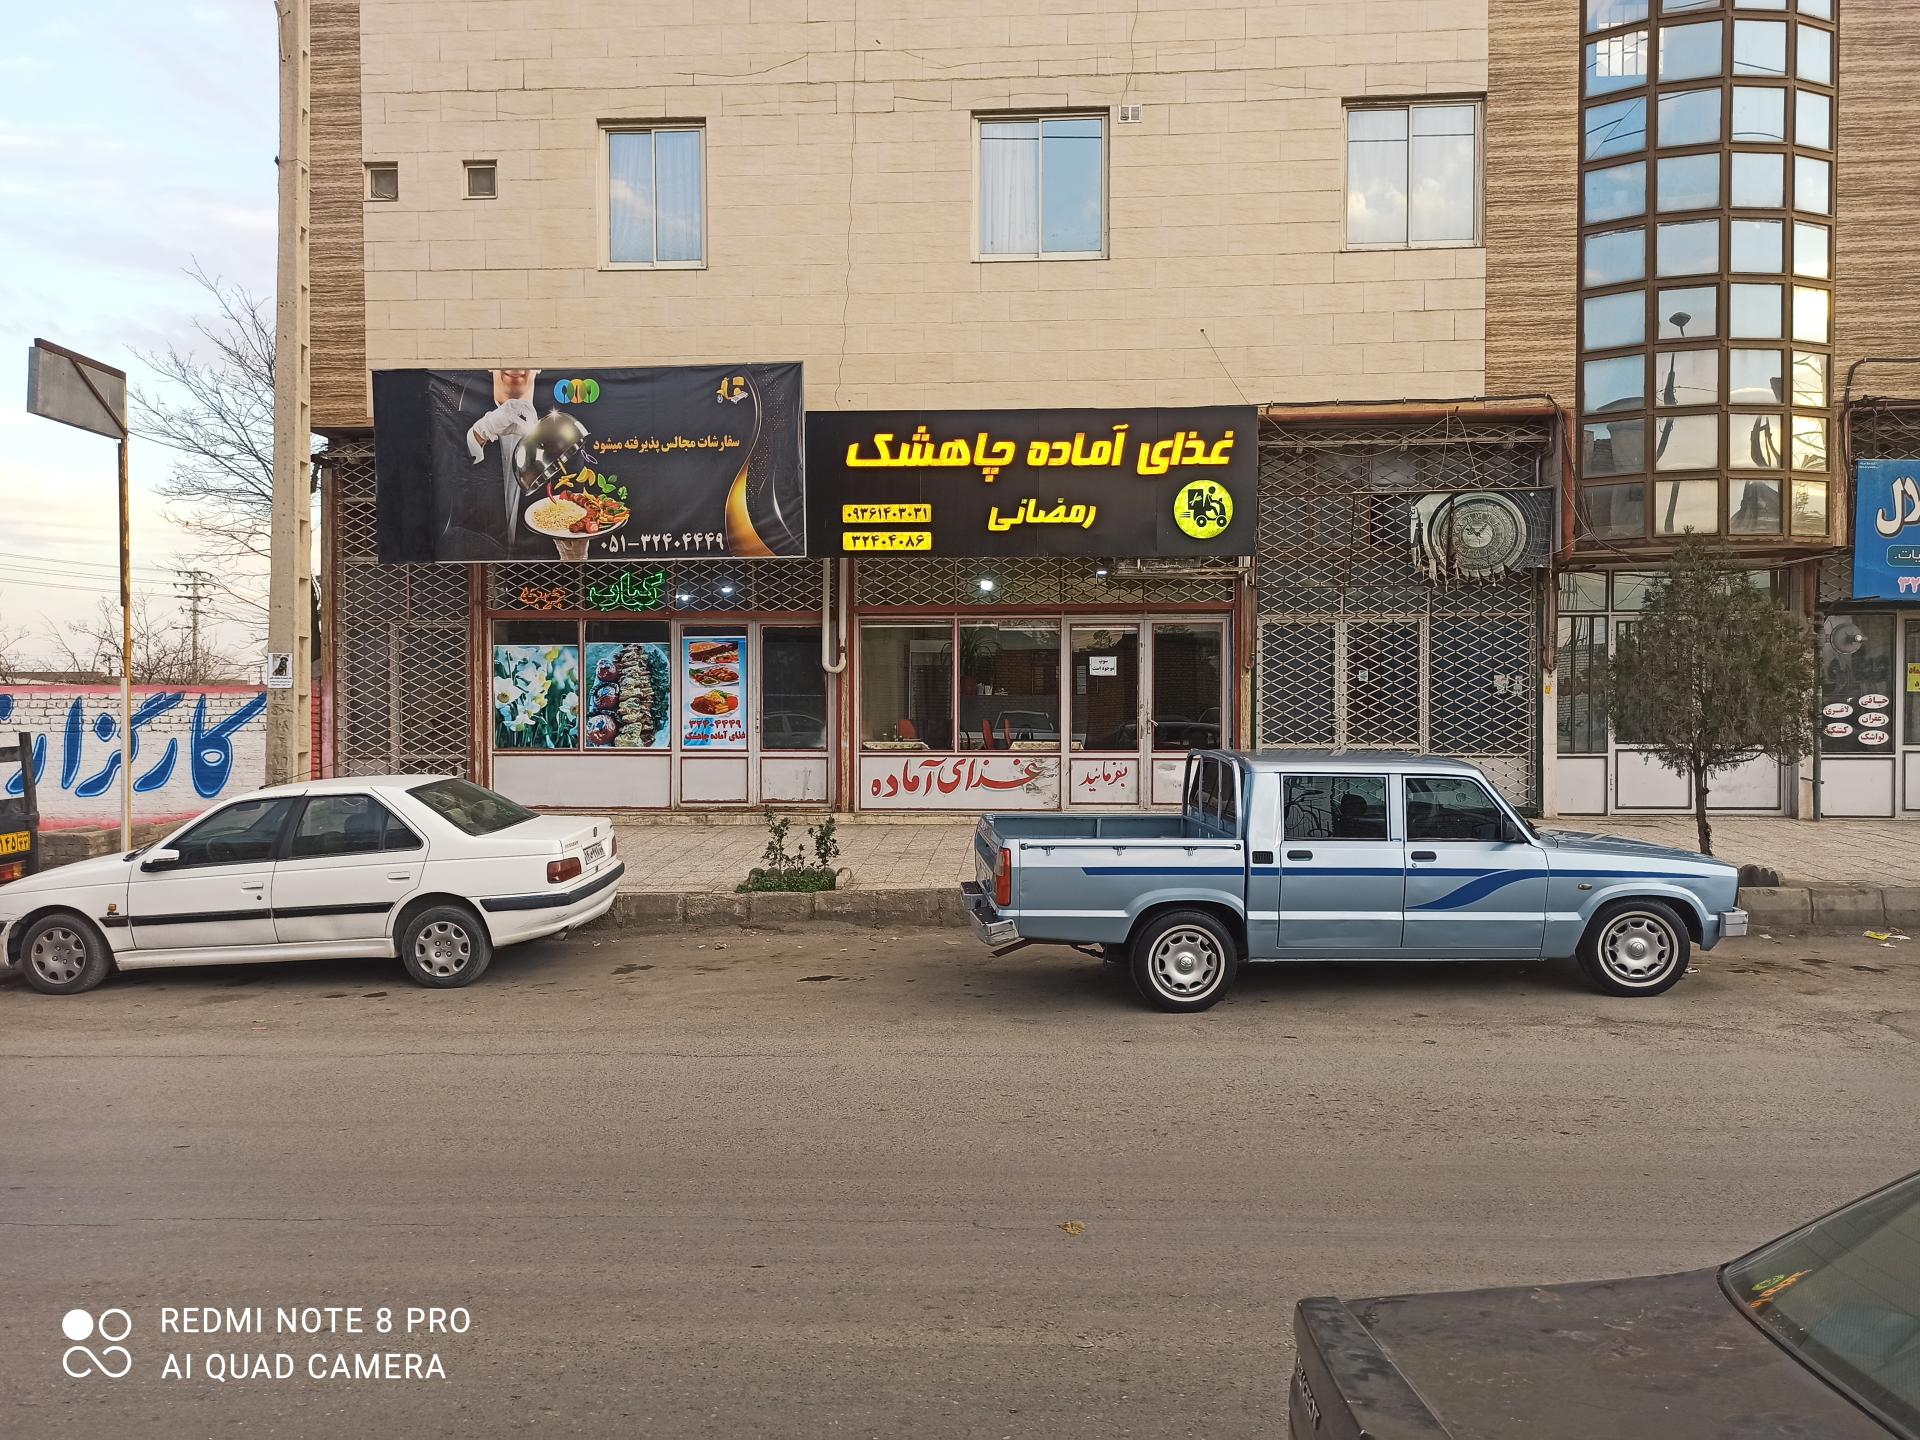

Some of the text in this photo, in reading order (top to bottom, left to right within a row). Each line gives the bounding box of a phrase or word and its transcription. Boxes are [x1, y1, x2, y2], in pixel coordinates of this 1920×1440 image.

[592, 435, 740, 454] سفارشات مجالس پذیرفته میشود
[845, 424, 1235, 483] غذای آماده چاهشک
[847, 507, 927, 520] ۰۹۳۶۱۴۰۳۰۳۱
[987, 498, 1097, 532] رمضانی
[851, 534, 926, 548] ۳۲۴۰۴۰۸۶
[1861, 713, 1886, 724] زعفران
[710, 730, 728, 740] آماده
[871, 757, 1045, 797] غذای آماده
